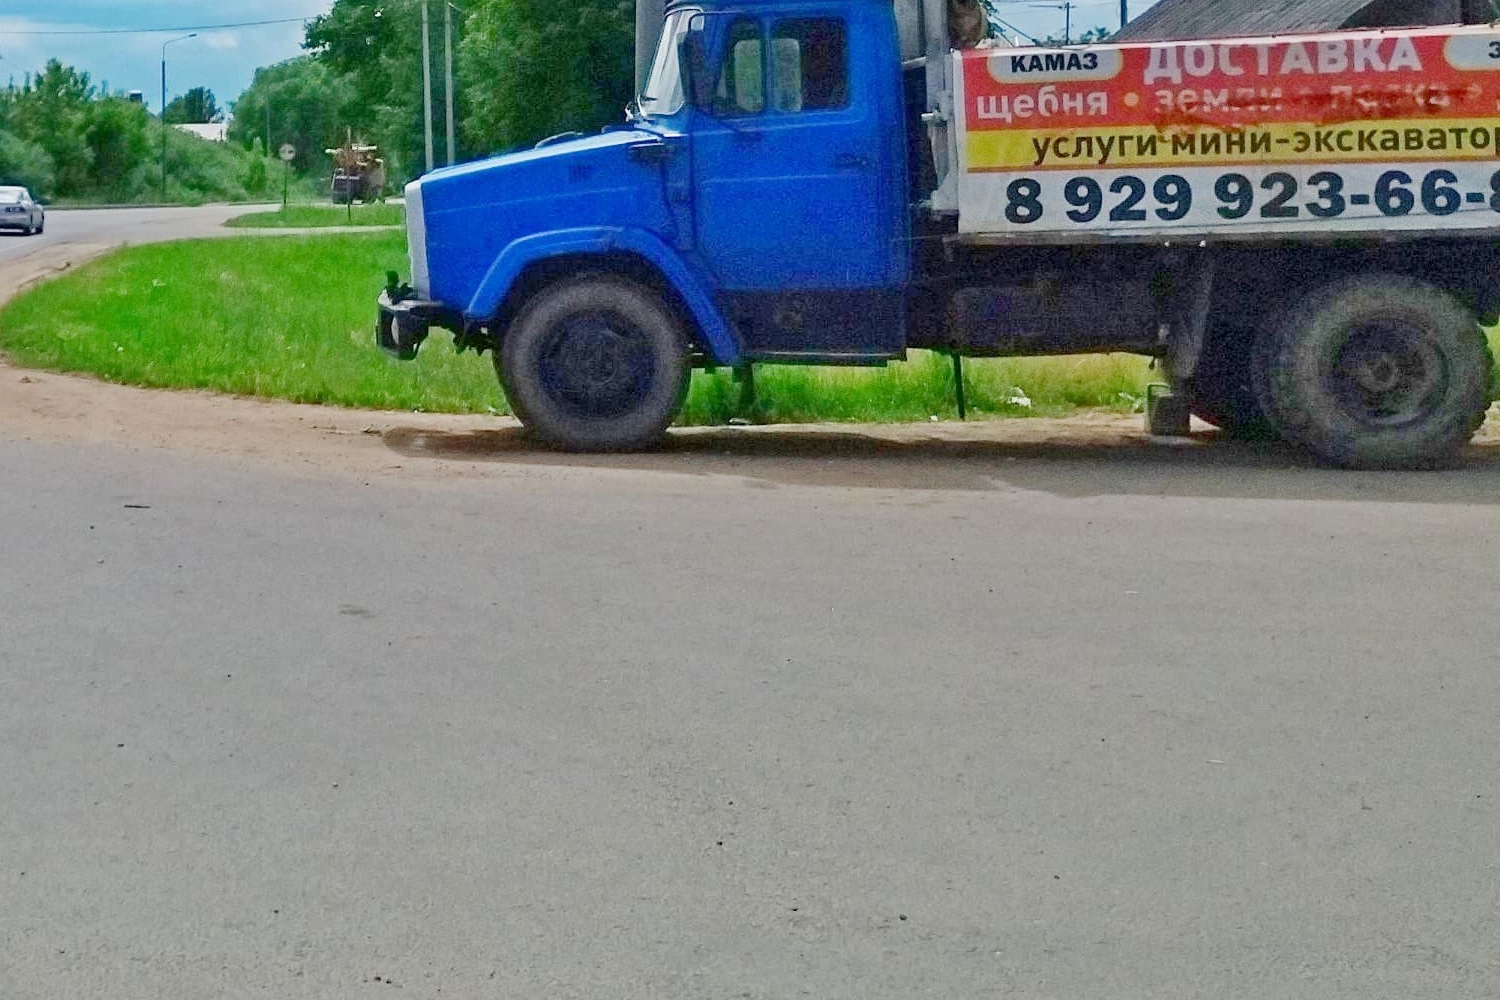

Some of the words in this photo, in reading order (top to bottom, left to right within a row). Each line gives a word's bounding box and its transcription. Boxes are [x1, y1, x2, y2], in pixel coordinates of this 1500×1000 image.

[1011, 53, 1098, 73] КАМАЗ
[1143, 36, 1423, 85] ДОСТАВКА
[977, 85, 1108, 123] щебня
[1032, 134, 1157, 166] услуги
[1172, 126, 1500, 157] мини-экскавато
[1005, 178, 1043, 223] 8
[1064, 173, 1192, 222] 929
[1214, 168, 1500, 220] 923-66-
